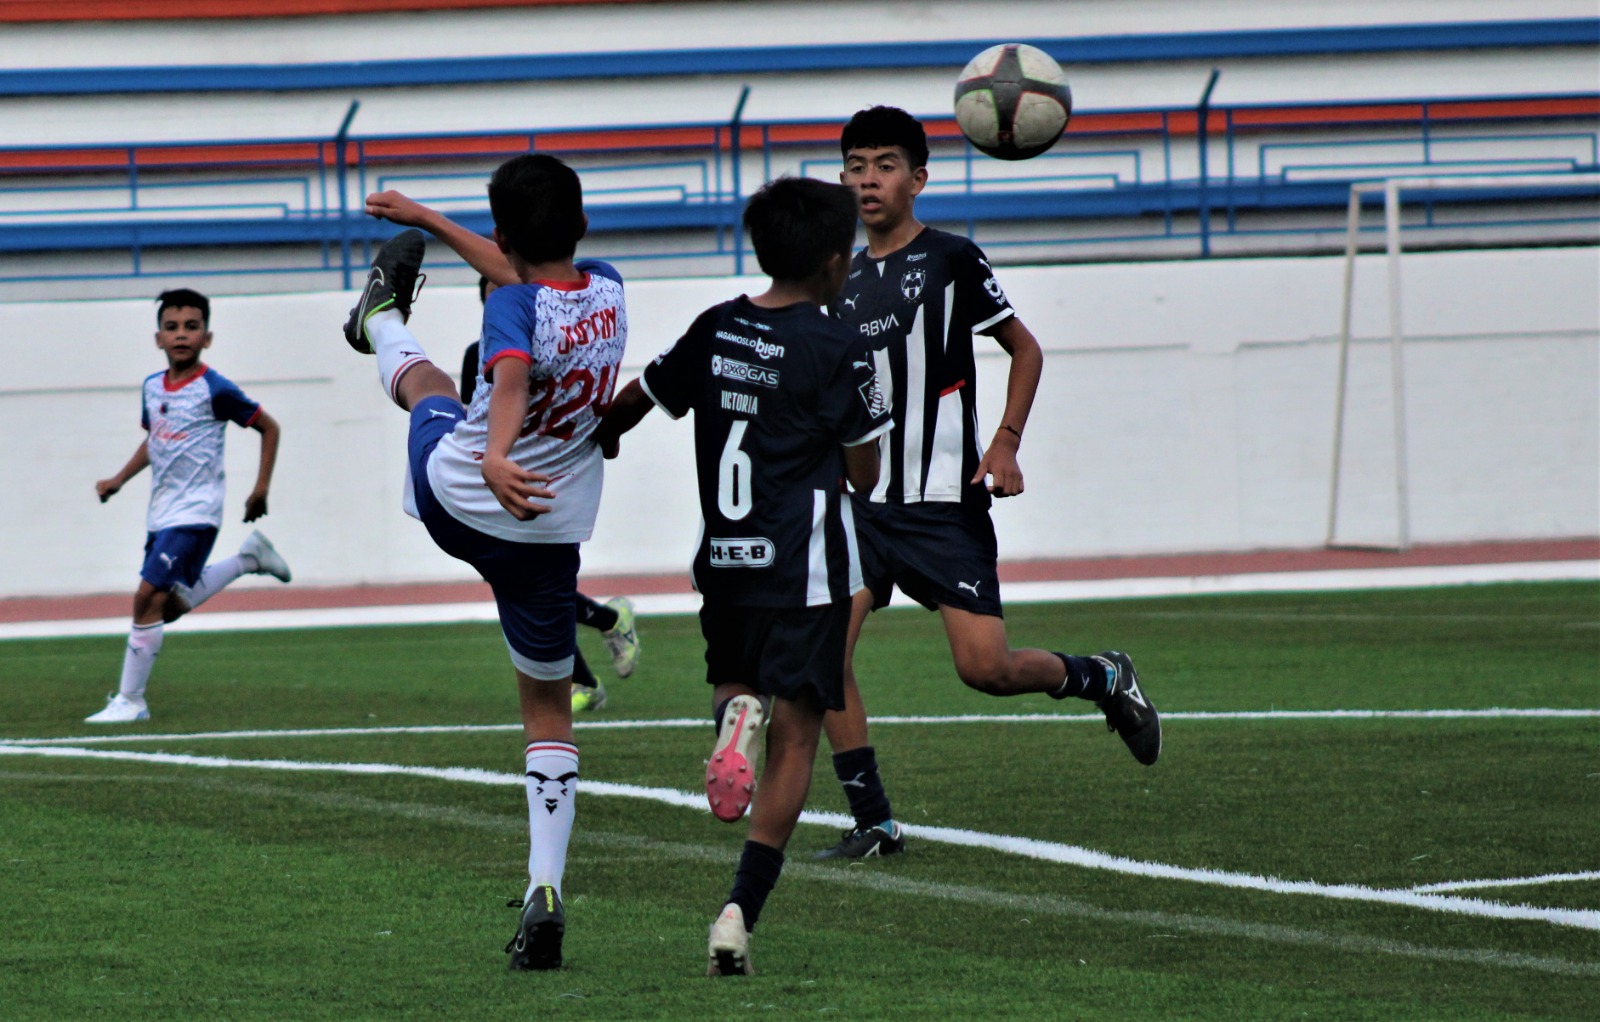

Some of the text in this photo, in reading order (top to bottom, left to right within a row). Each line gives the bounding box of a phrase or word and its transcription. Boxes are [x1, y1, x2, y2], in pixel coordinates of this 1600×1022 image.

[860, 313, 900, 337] BBVA
[755, 336, 785, 359] bien
[721, 389, 759, 415] VICTORIA
[717, 420, 753, 521] 6
